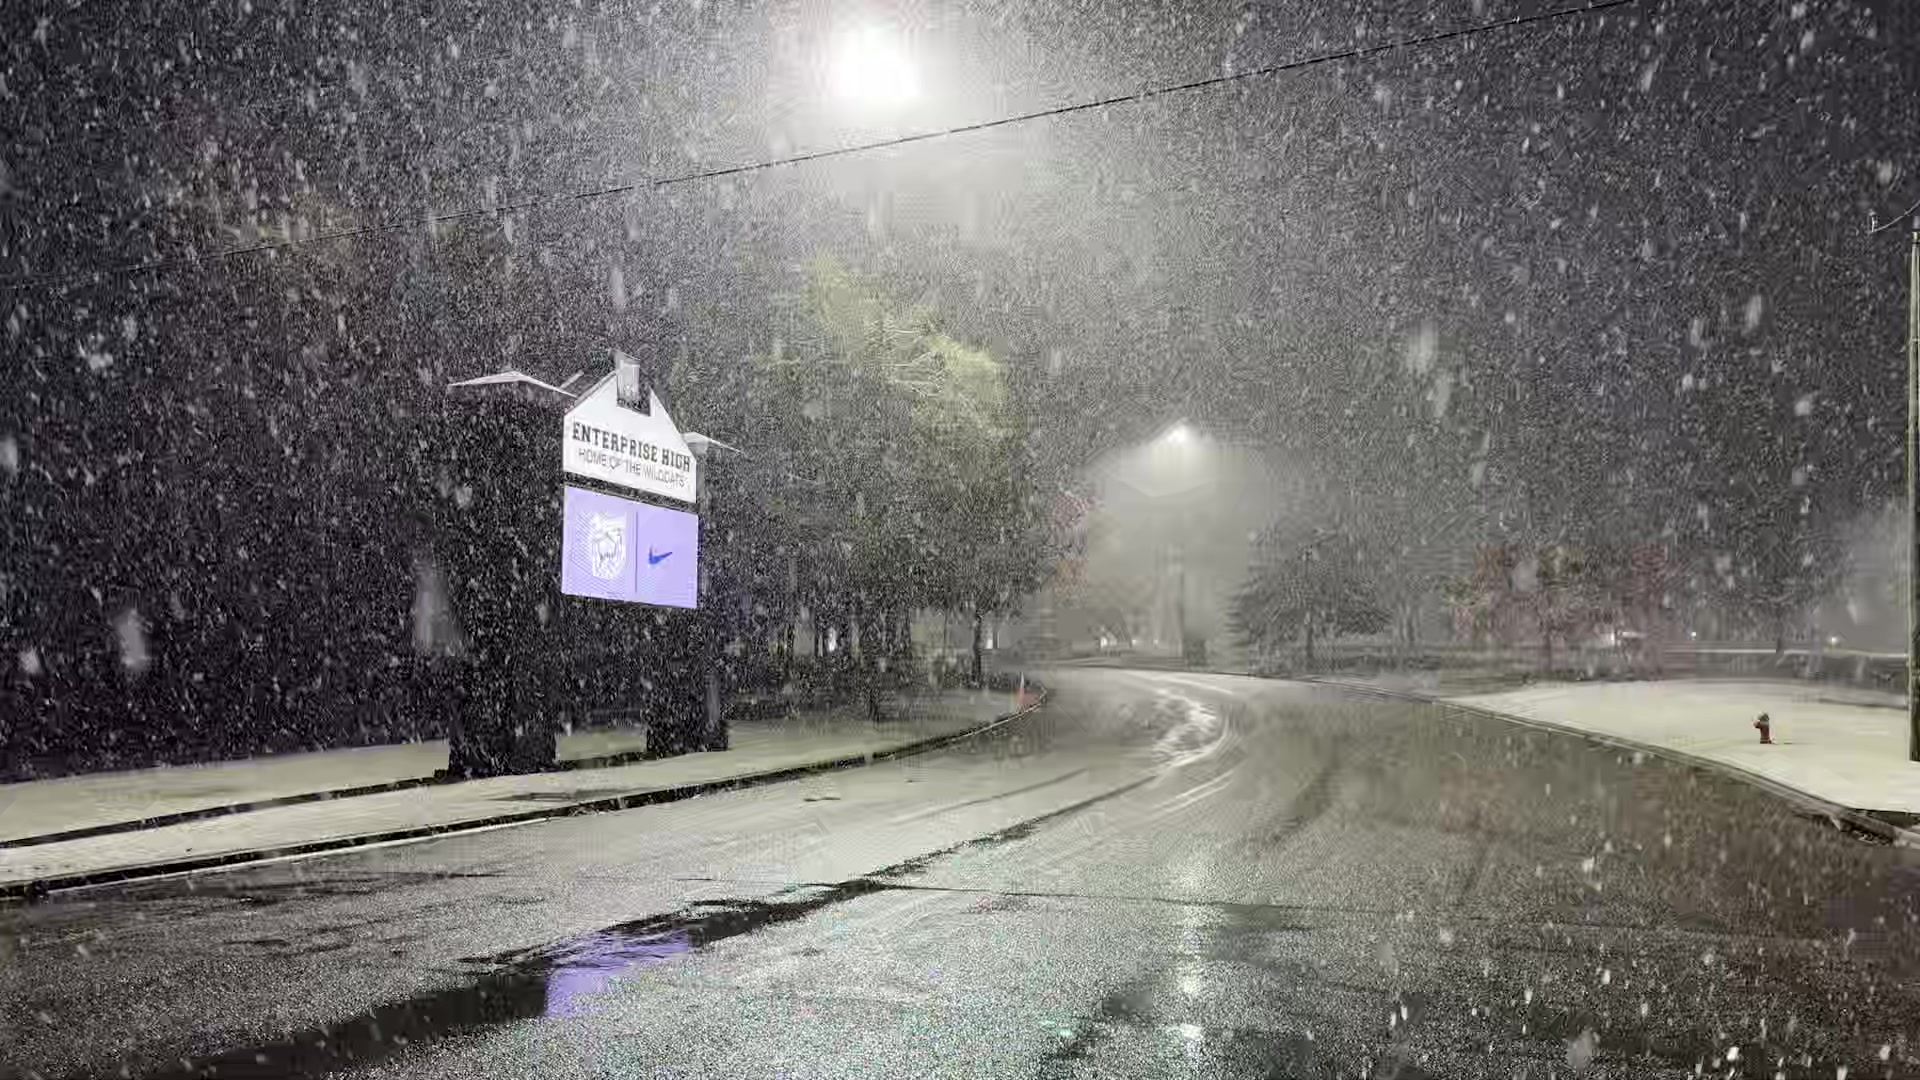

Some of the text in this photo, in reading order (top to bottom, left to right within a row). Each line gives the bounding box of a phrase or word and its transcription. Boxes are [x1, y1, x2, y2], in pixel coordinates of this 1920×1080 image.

[572, 422, 690, 472] ENTERPRISE HIGH
[579, 447, 606, 467] HOME
[625, 460, 641, 475] THE
